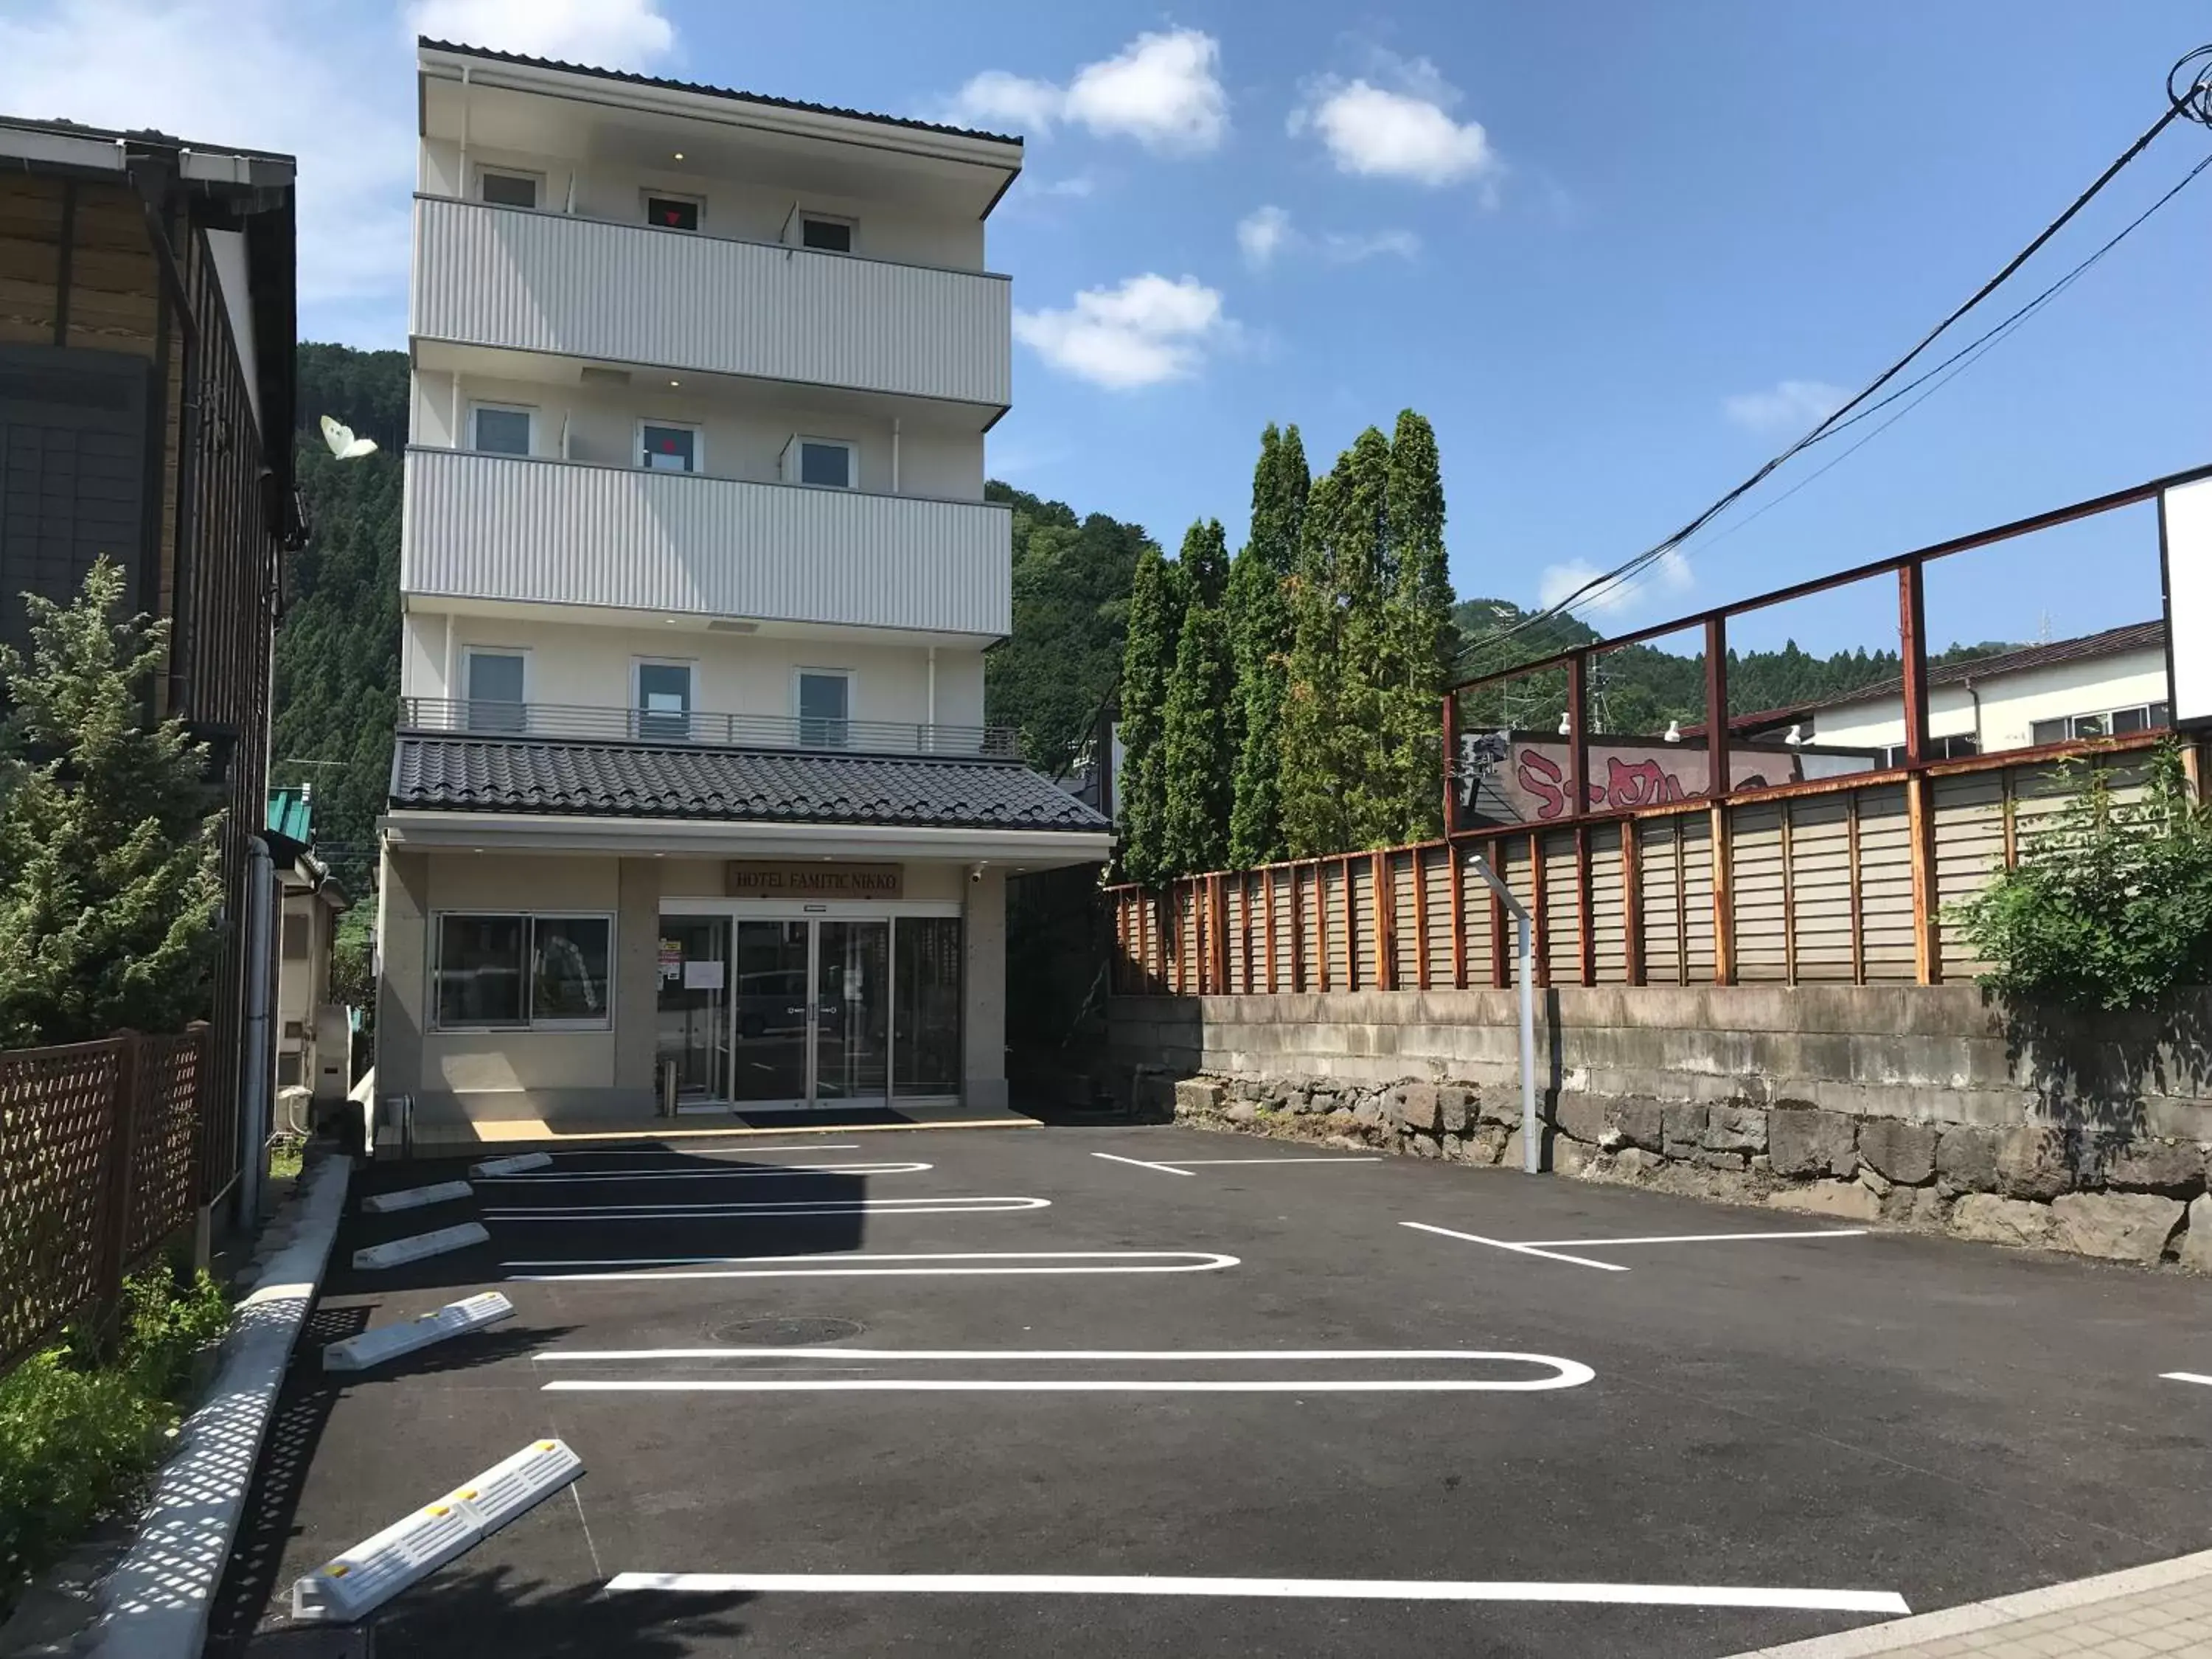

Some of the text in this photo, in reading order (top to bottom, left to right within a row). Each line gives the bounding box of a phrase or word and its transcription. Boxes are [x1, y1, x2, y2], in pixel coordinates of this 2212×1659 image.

[737, 872, 897, 890] HOTEL FAMITIC NIKKO
